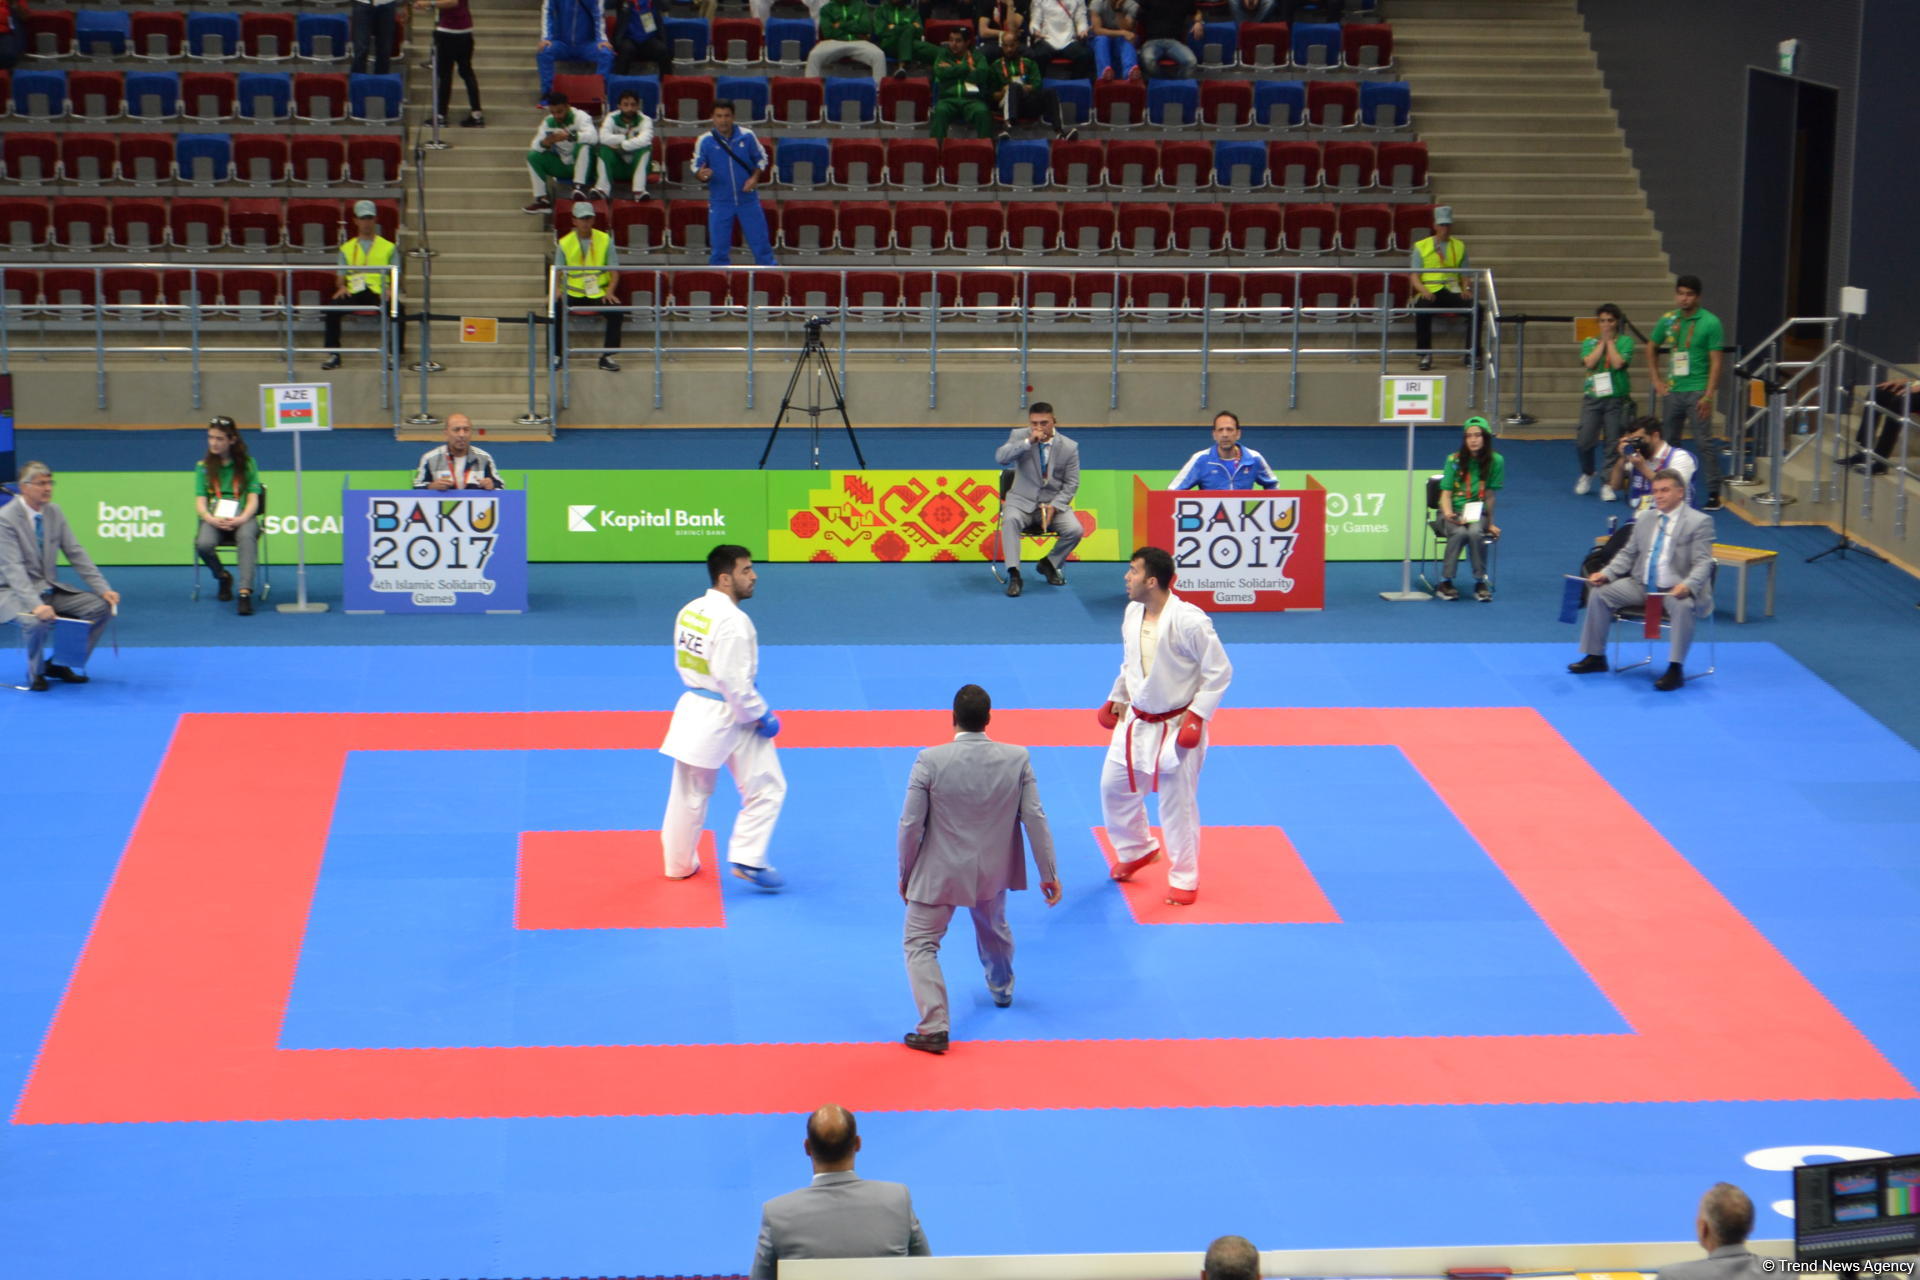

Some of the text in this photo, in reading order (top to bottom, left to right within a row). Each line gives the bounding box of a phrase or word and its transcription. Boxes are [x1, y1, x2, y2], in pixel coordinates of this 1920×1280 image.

[284, 390, 310, 400] AZE
[1406, 382, 1421, 392] IRI
[1326, 492, 1386, 517] 017
[264, 515, 344, 535] SOCA
[371, 500, 496, 533] BAKU
[600, 508, 726, 532] Kapital Bank
[1176, 500, 1297, 532] BAKU
[98, 522, 166, 542] aqua
[1343, 521, 1390, 533] Games
[371, 535, 494, 570] 2017
[1175, 535, 1294, 569] 2017
[374, 579, 493, 593] 4th Islamic Solidarity
[1176, 578, 1292, 591] 4th Islamic Solidarity
[415, 593, 455, 604] Games
[1215, 592, 1254, 603] Games
[679, 630, 704, 655] AZE
